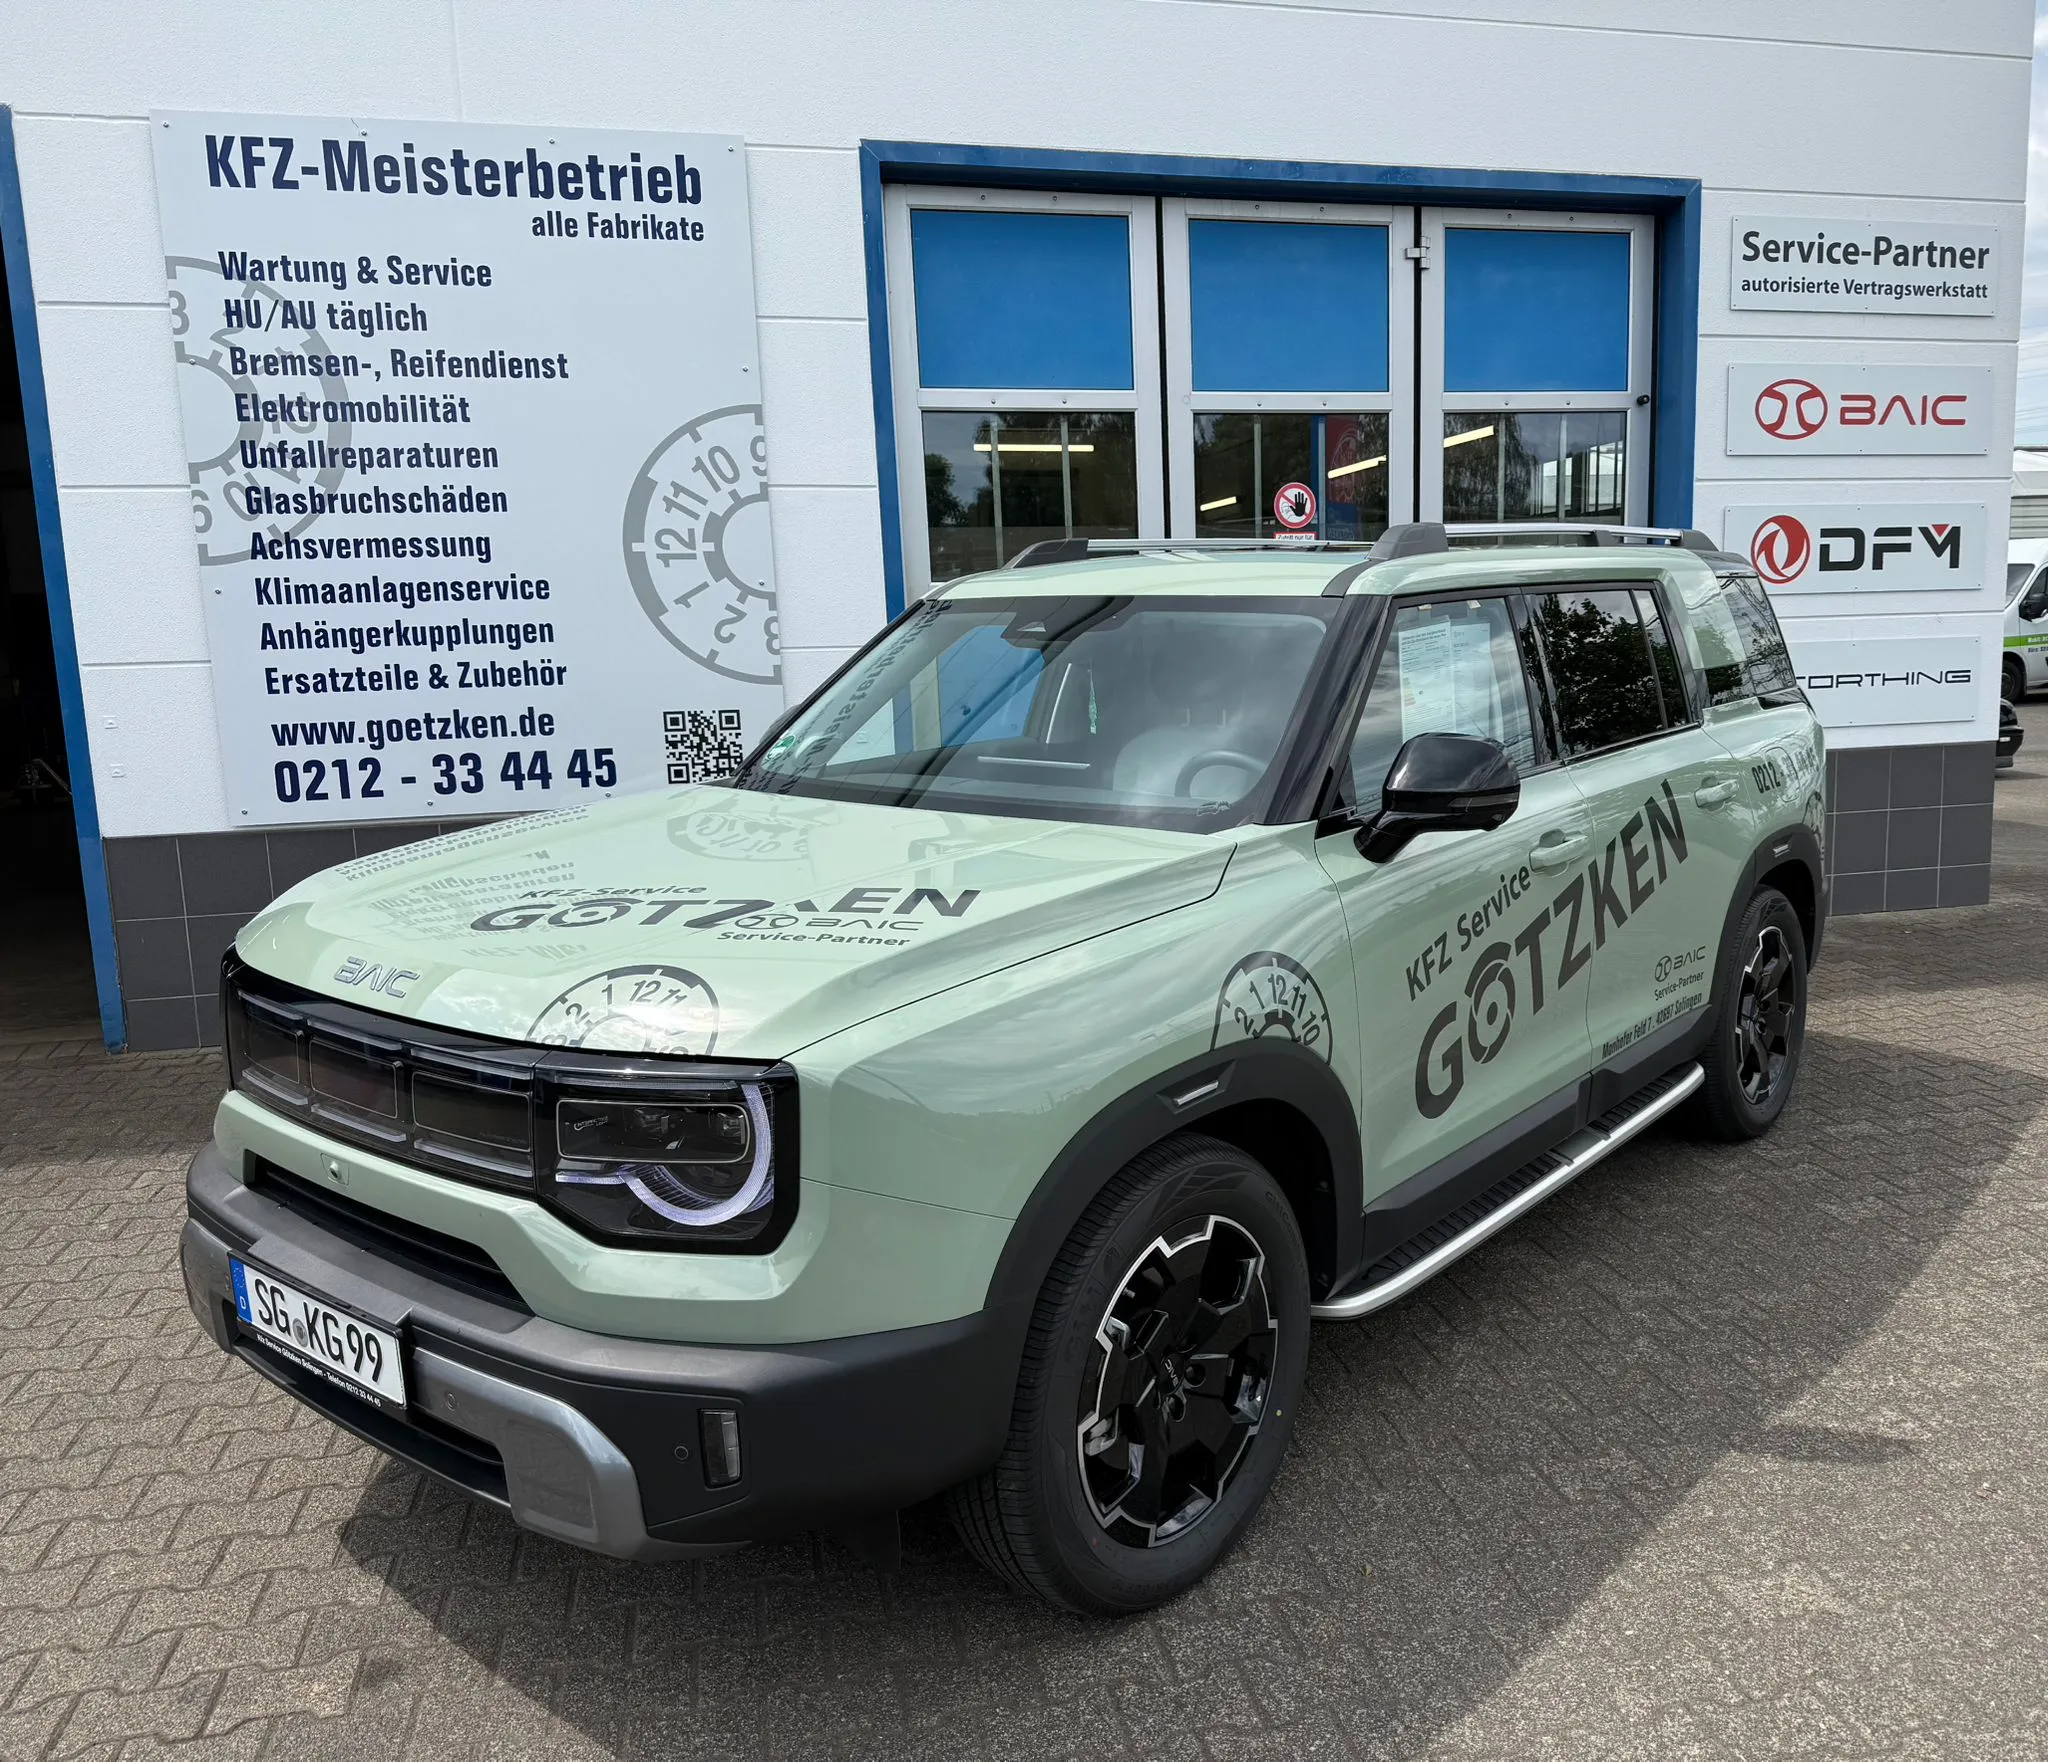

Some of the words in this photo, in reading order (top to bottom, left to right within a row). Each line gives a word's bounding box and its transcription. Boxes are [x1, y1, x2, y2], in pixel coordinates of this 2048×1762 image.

[205, 134, 702, 205] KFZ-Meisterbetrieb
[531, 211, 579, 238] alle
[586, 212, 705, 242] Fabrikate
[1741, 231, 1991, 270] Service-Partner
[218, 250, 348, 291] Wartung
[356, 256, 379, 285] &
[387, 255, 493, 288] Service
[1741, 276, 1840, 296] autorisierte
[1843, 278, 1989, 300] Vertragswerkstatt
[224, 298, 317, 334] HU/AU
[326, 300, 428, 339] täglich
[229, 346, 381, 382] Bremsen-,
[390, 349, 570, 381] Reifendienst
[235, 392, 471, 425] Elektromobilität
[1839, 394, 1968, 426] BAIC
[240, 439, 499, 476] Unfallreparaturen
[691, 445, 741, 493] 10
[244, 485, 509, 516] Glasbruchschäden
[250, 532, 492, 564] Achsvermessung
[654, 528, 698, 568] 12
[1818, 523, 1961, 572] DFM
[254, 573, 551, 609] Klimaanlagenservice
[260, 618, 555, 654] Anhängerkupplungen
[265, 663, 419, 696] Ersatzteile
[428, 664, 449, 689] &
[458, 660, 568, 690] Zubehör
[1796, 669, 1972, 690] ORTHING
[271, 706, 556, 750] www.goetzken.de
[273, 756, 385, 804] 0212
[400, 775, 418, 786] -
[431, 752, 485, 796] 33
[499, 750, 552, 791] 44
[566, 747, 618, 788] 45
[1751, 761, 1781, 793] 0212
[520, 885, 708, 900] KFZ-Service
[716, 931, 911, 947] Service-Partner
[805, 917, 924, 931] BAIC
[1405, 931, 1453, 1002] KFZ
[1457, 865, 1532, 952] Service
[1673, 945, 1706, 970] BAIC
[333, 955, 420, 999] BAIC
[629, 980, 662, 1003] 12
[1267, 973, 1289, 1006] 12
[1654, 971, 1705, 1001] Service-Partner
[1249, 980, 1265, 1009] 1
[1291, 985, 1307, 1019] 11
[565, 1003, 591, 1025] 2
[1234, 1006, 1255, 1035] 2
[1301, 1010, 1321, 1046] 10
[239, 1296, 247, 1310] D
[254, 1278, 292, 1337] SG
[326, 1371, 346, 1390] Telefon
[345, 1382, 360, 1396] 0212
